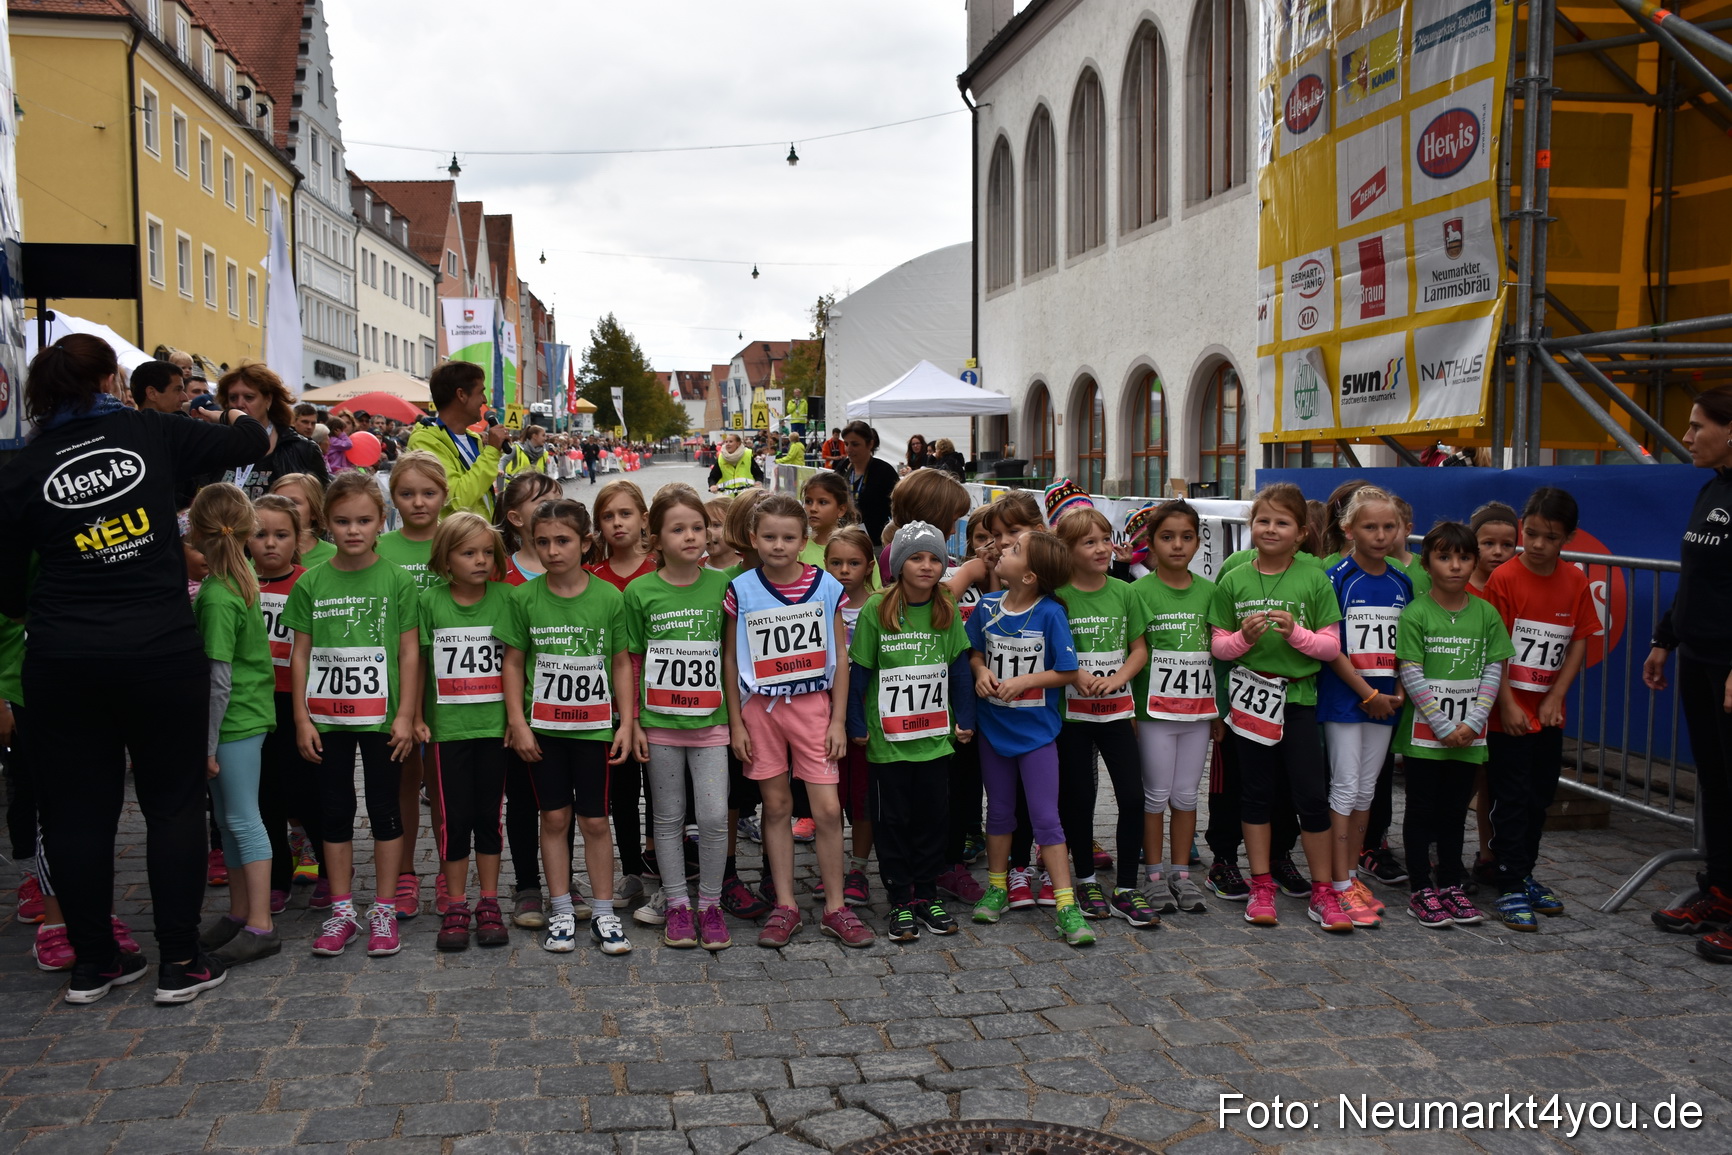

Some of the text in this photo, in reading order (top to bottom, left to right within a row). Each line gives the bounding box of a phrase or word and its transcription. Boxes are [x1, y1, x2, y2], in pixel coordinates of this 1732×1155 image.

[1457, 7, 1487, 31] Tagblatt
[1372, 68, 1395, 89] KANN
[1289, 86, 1321, 121] Hervis
[1424, 122, 1474, 162] Hervis
[1360, 182, 1376, 205] DEHN
[1291, 268, 1317, 284] GERHART
[1432, 262, 1480, 282] Neumarkter
[1360, 284, 1384, 304] Braun
[1424, 275, 1490, 303] Lammsbräu
[1302, 311, 1315, 325] KIA
[1421, 354, 1484, 386] NATHUS
[1342, 370, 1381, 395] swn
[1295, 390, 1319, 418] SCHAU
[1341, 392, 1396, 405] stadtwerke neumarkt
[508, 412, 518, 424] A
[735, 419, 741, 427] B
[756, 411, 766, 423] A
[56, 435, 106, 456] www.hervis.com
[52, 459, 138, 499] Hervis
[67, 486, 105, 504] SPORTS
[74, 507, 150, 552] NEU
[81, 533, 155, 561] IN NEUMARKT
[314, 596, 366, 607] Neumarkter
[313, 607, 354, 619] Stadtlauf
[651, 608, 703, 622] Neumarkter
[748, 611, 813, 627] PARTL Neumarkt
[1070, 616, 1109, 625] umarkter
[1348, 613, 1374, 621] PARTL
[530, 625, 583, 634] Neumarkter
[652, 619, 694, 633] Stadtlauf
[1147, 622, 1186, 632] Stadtlauf
[1515, 626, 1541, 636] PARTL
[436, 635, 462, 643] PARTL
[756, 621, 822, 656] 7024
[881, 631, 931, 641] Neumarkter
[1355, 624, 1396, 650] 718
[650, 647, 711, 656] PARTL Neumarkt
[881, 642, 922, 652] Stadtlauf
[997, 642, 1031, 653] Neumarkt
[1520, 637, 1565, 667] 713
[442, 645, 503, 674] 7435
[537, 660, 561, 670] PARTL
[776, 658, 812, 673] Sophia
[987, 650, 1037, 679] 7117
[1153, 657, 1177, 665] PARTL
[1376, 657, 1395, 667] Alin
[317, 666, 380, 695] 7053
[655, 659, 716, 687] 7038
[881, 672, 939, 683] PARTL Neumarkt
[542, 673, 605, 702] 7084
[1158, 668, 1212, 694] 7414
[671, 694, 699, 706] Maya
[886, 682, 943, 712] 7174
[1231, 678, 1282, 719] 7437
[333, 702, 355, 713] Lisa
[554, 709, 589, 720] Emilia
[1091, 703, 1117, 713] Marie
[902, 718, 930, 730] Emilia
